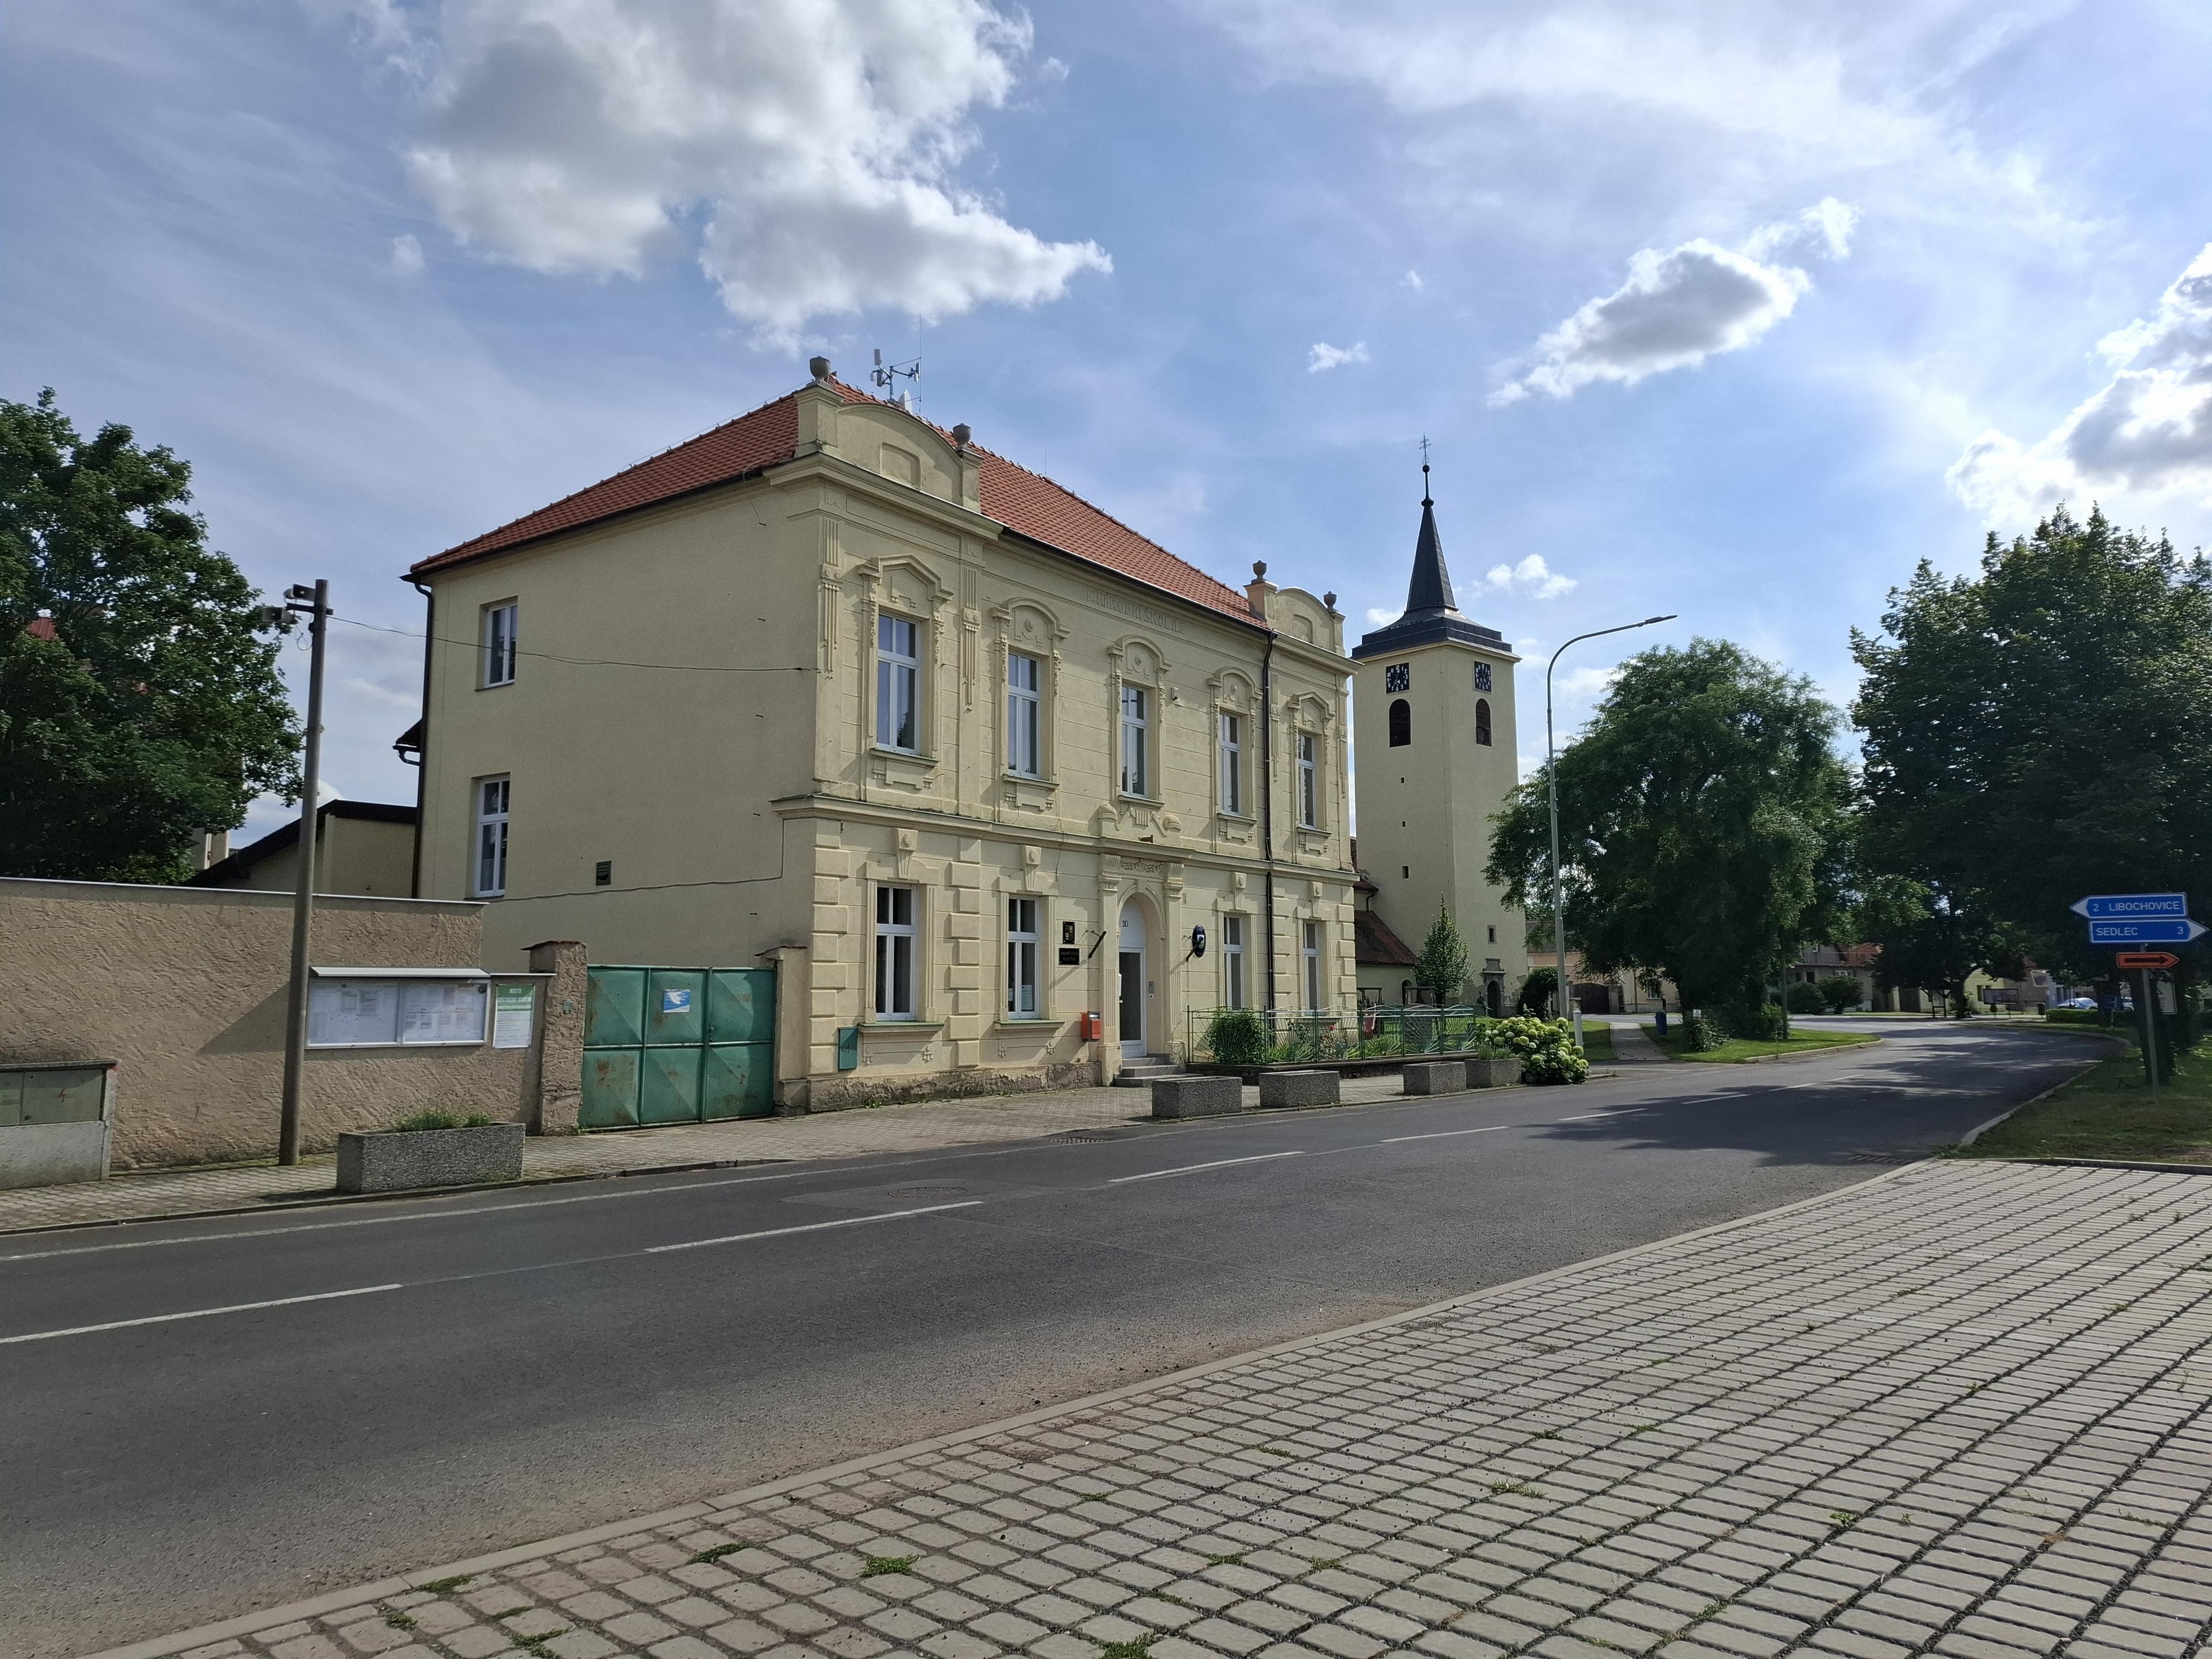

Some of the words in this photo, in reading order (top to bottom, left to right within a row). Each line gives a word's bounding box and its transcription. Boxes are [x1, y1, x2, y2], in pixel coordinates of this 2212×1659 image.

[2093, 904, 2100, 912] 2
[2109, 901, 2180, 911] LIBOCHOVICE
[2096, 927, 2138, 936] SEDLEC
[2177, 926, 2184, 935] 3
